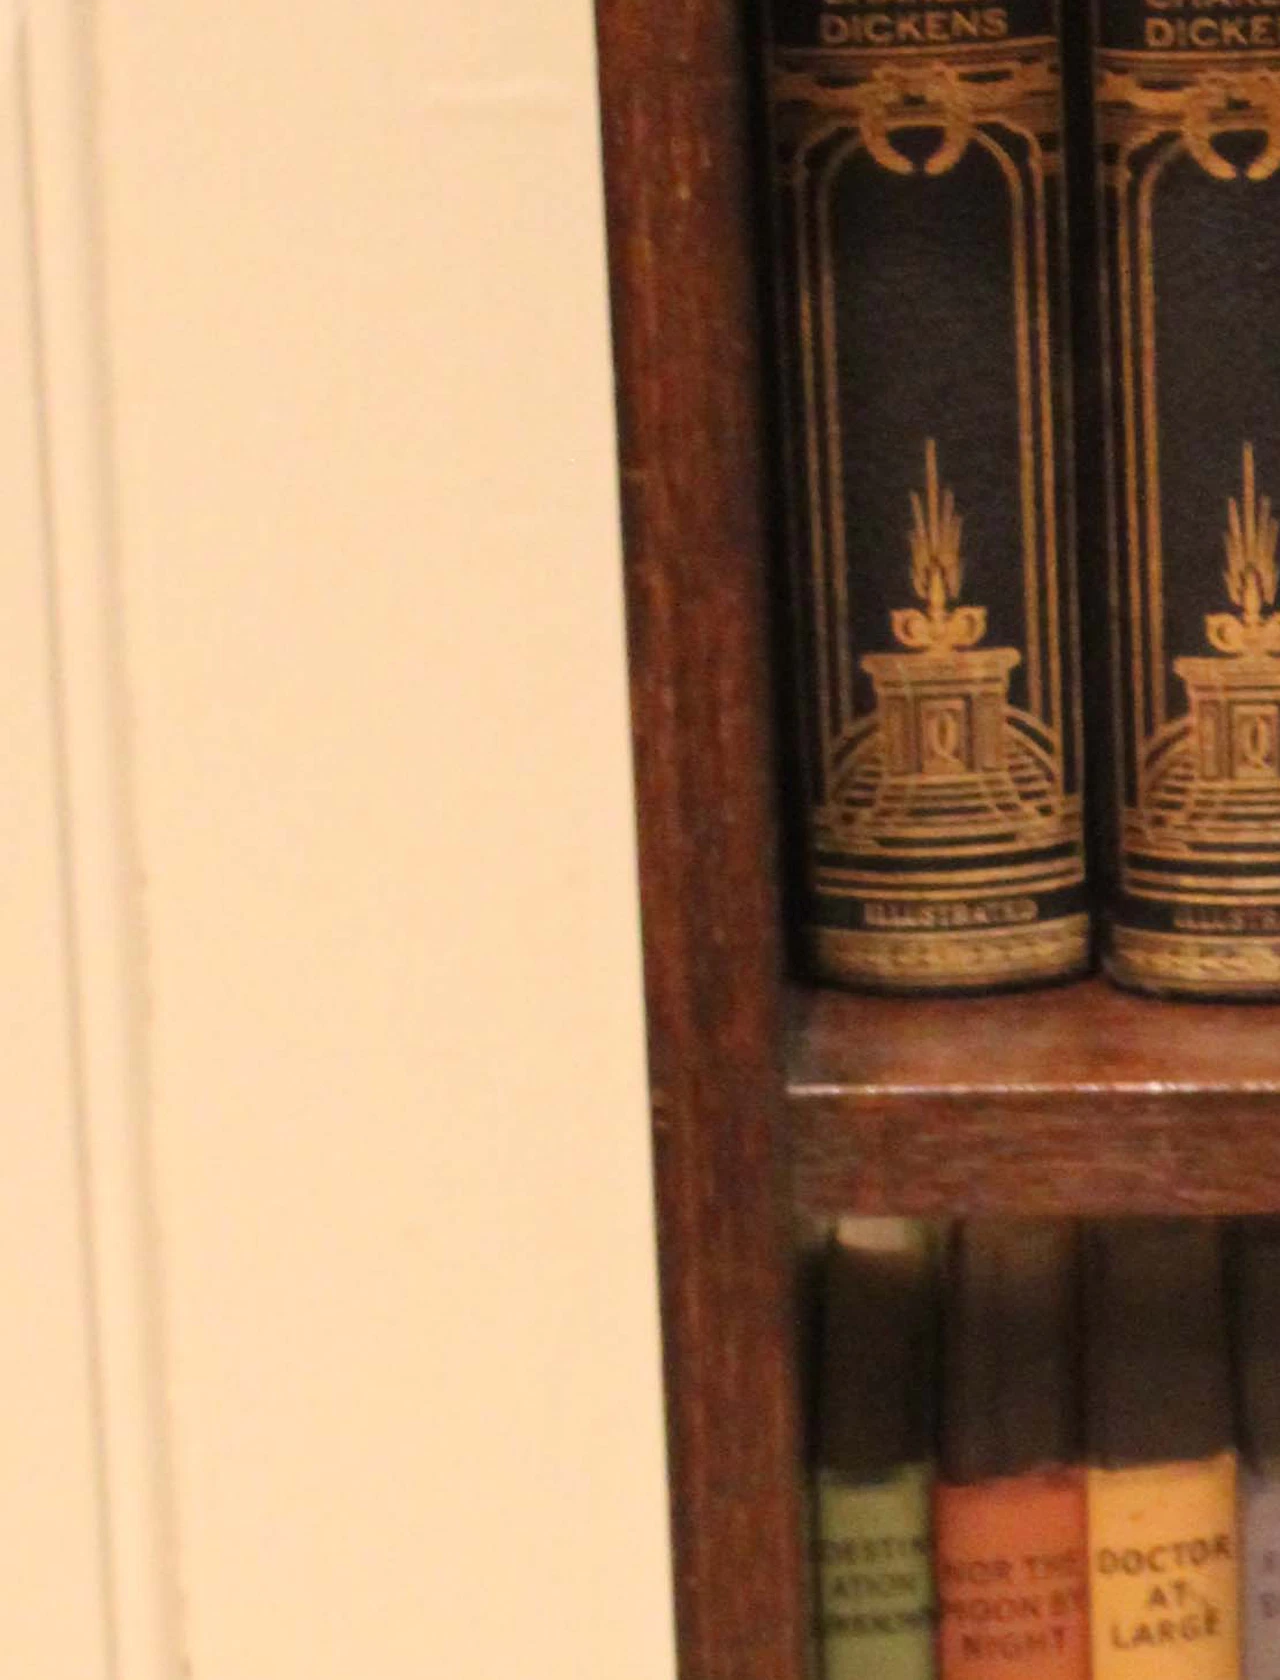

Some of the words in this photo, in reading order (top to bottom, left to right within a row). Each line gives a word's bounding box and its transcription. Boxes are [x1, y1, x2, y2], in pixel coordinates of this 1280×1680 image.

[819, 8, 1008, 44] DICKENS
[1098, 1534, 1230, 1577] DOCTOR
[1147, 1581, 1187, 1608] AT
[961, 1628, 1067, 1661] NIGHT
[1110, 1607, 1221, 1650] LARGE
